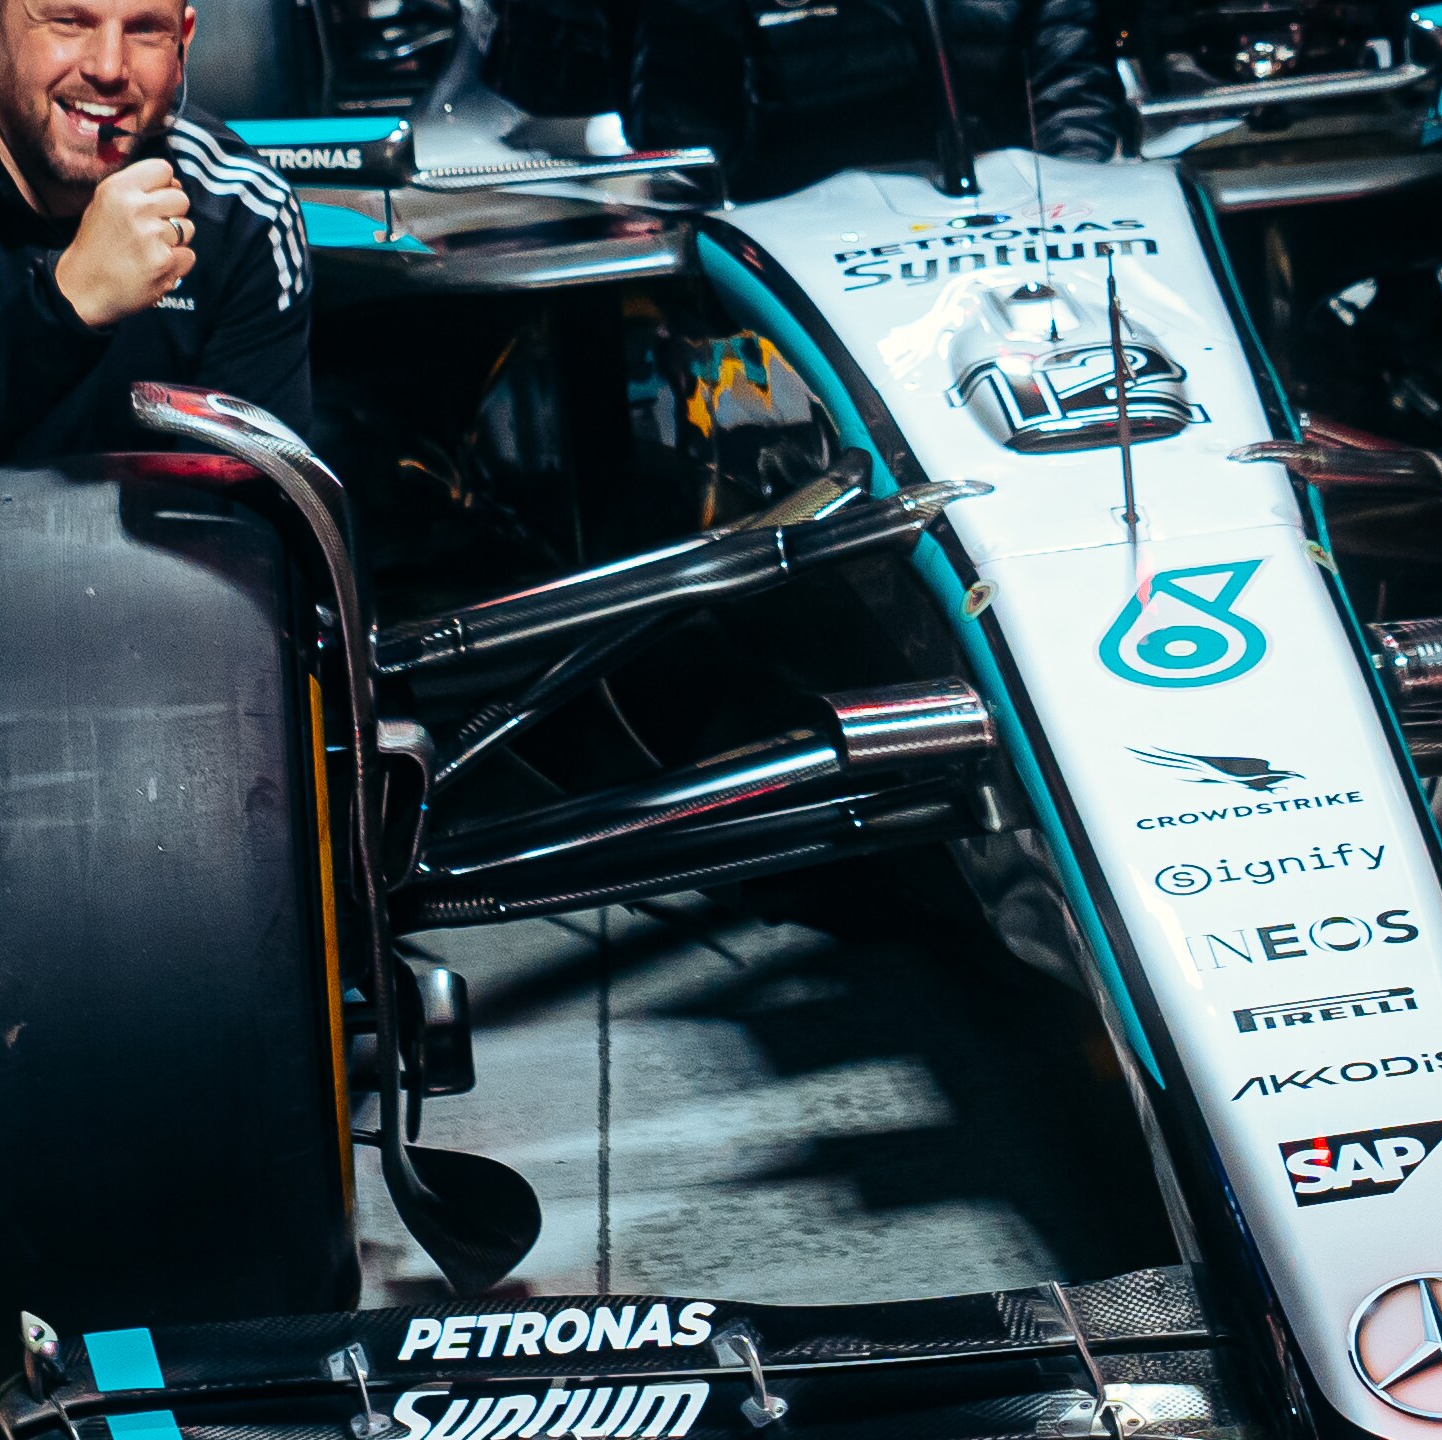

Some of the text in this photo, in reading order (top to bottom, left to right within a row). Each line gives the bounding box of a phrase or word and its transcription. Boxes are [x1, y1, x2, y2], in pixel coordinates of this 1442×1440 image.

[258, 148, 361, 169] TRONAS
[834, 219, 1145, 263] PETRONAS
[844, 238, 1158, 291] Syntium
[945, 343, 1212, 433] 12
[1136, 790, 1365, 831] CROWDSTRIKE
[1186, 910, 1420, 972] INEOS
[1233, 986, 1420, 1034] PIRELLI
[1286, 1136, 1427, 1196] SAP
[397, 1300, 717, 1363] PETRONAS
